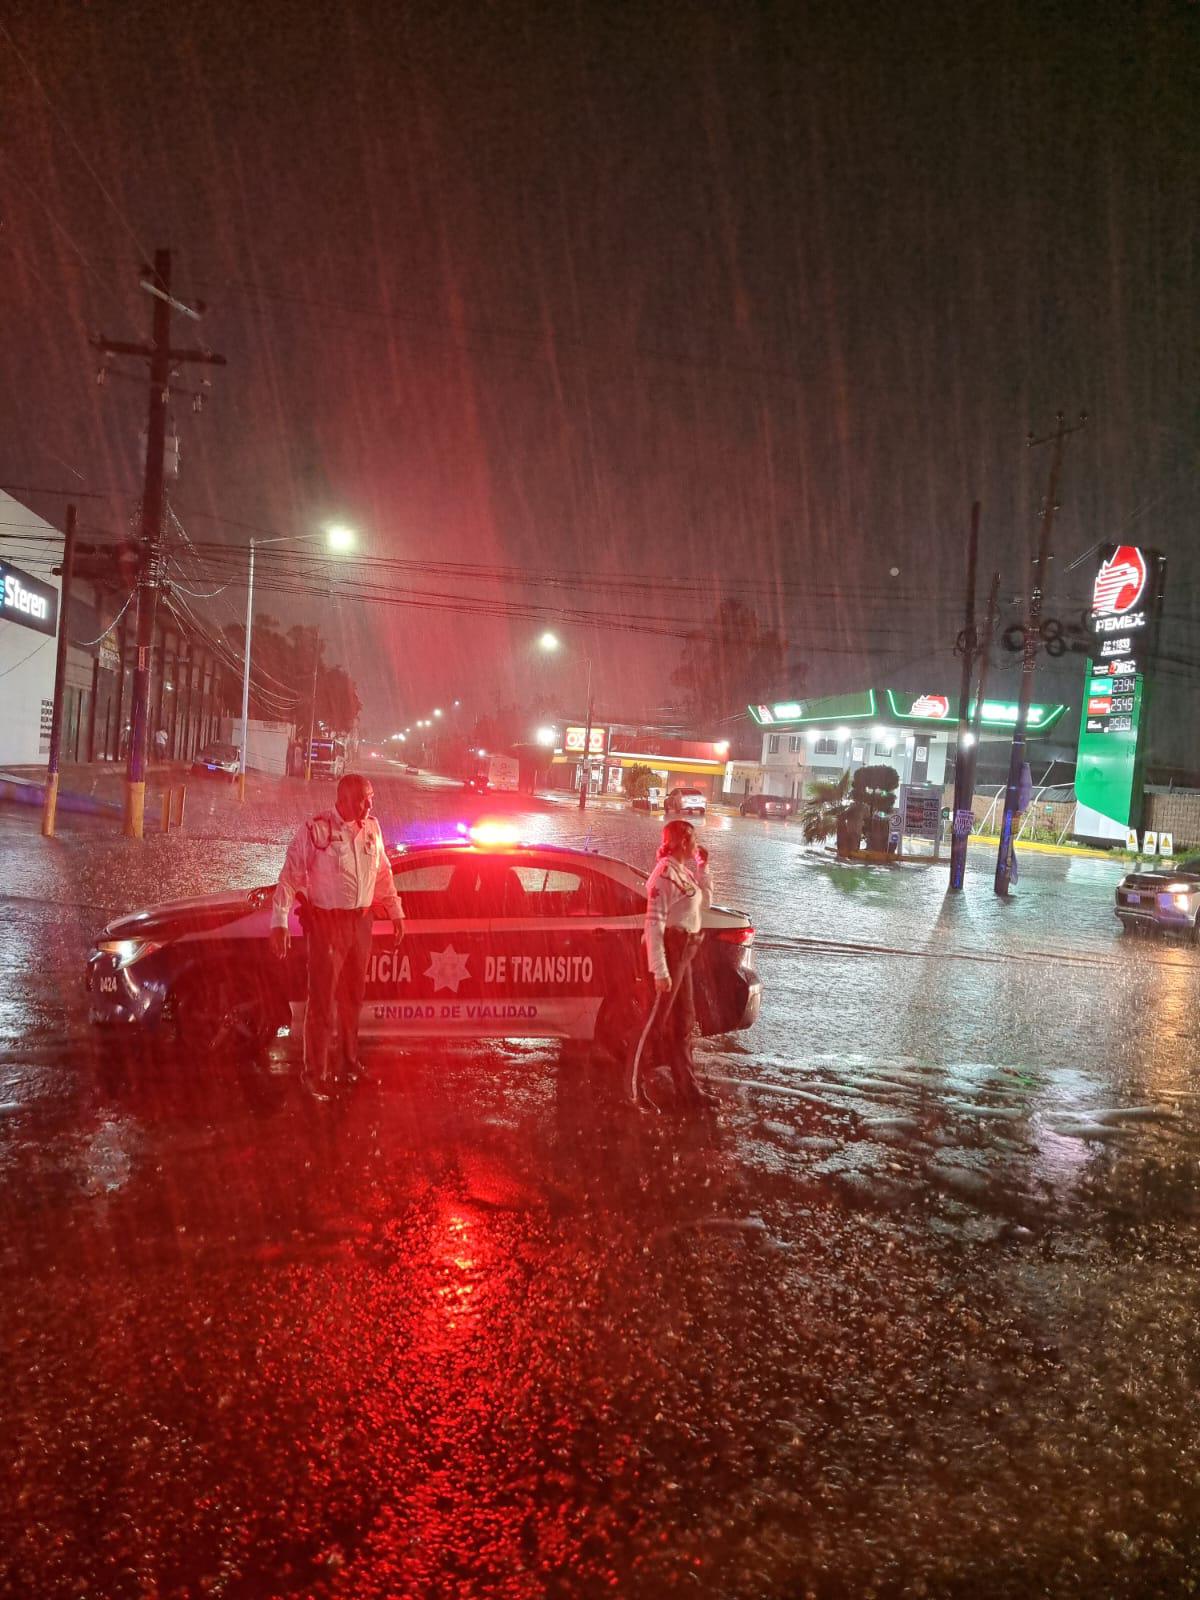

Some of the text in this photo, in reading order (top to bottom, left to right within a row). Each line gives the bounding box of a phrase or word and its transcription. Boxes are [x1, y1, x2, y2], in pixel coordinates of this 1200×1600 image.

[5, 575, 46, 619] Steren
[1095, 612, 1145, 633] PEMEX
[485, 956, 506, 983] DE
[512, 956, 593, 983] TRANSITO
[374, 1005, 538, 1019] UNIDAD DE VIALIDAD
